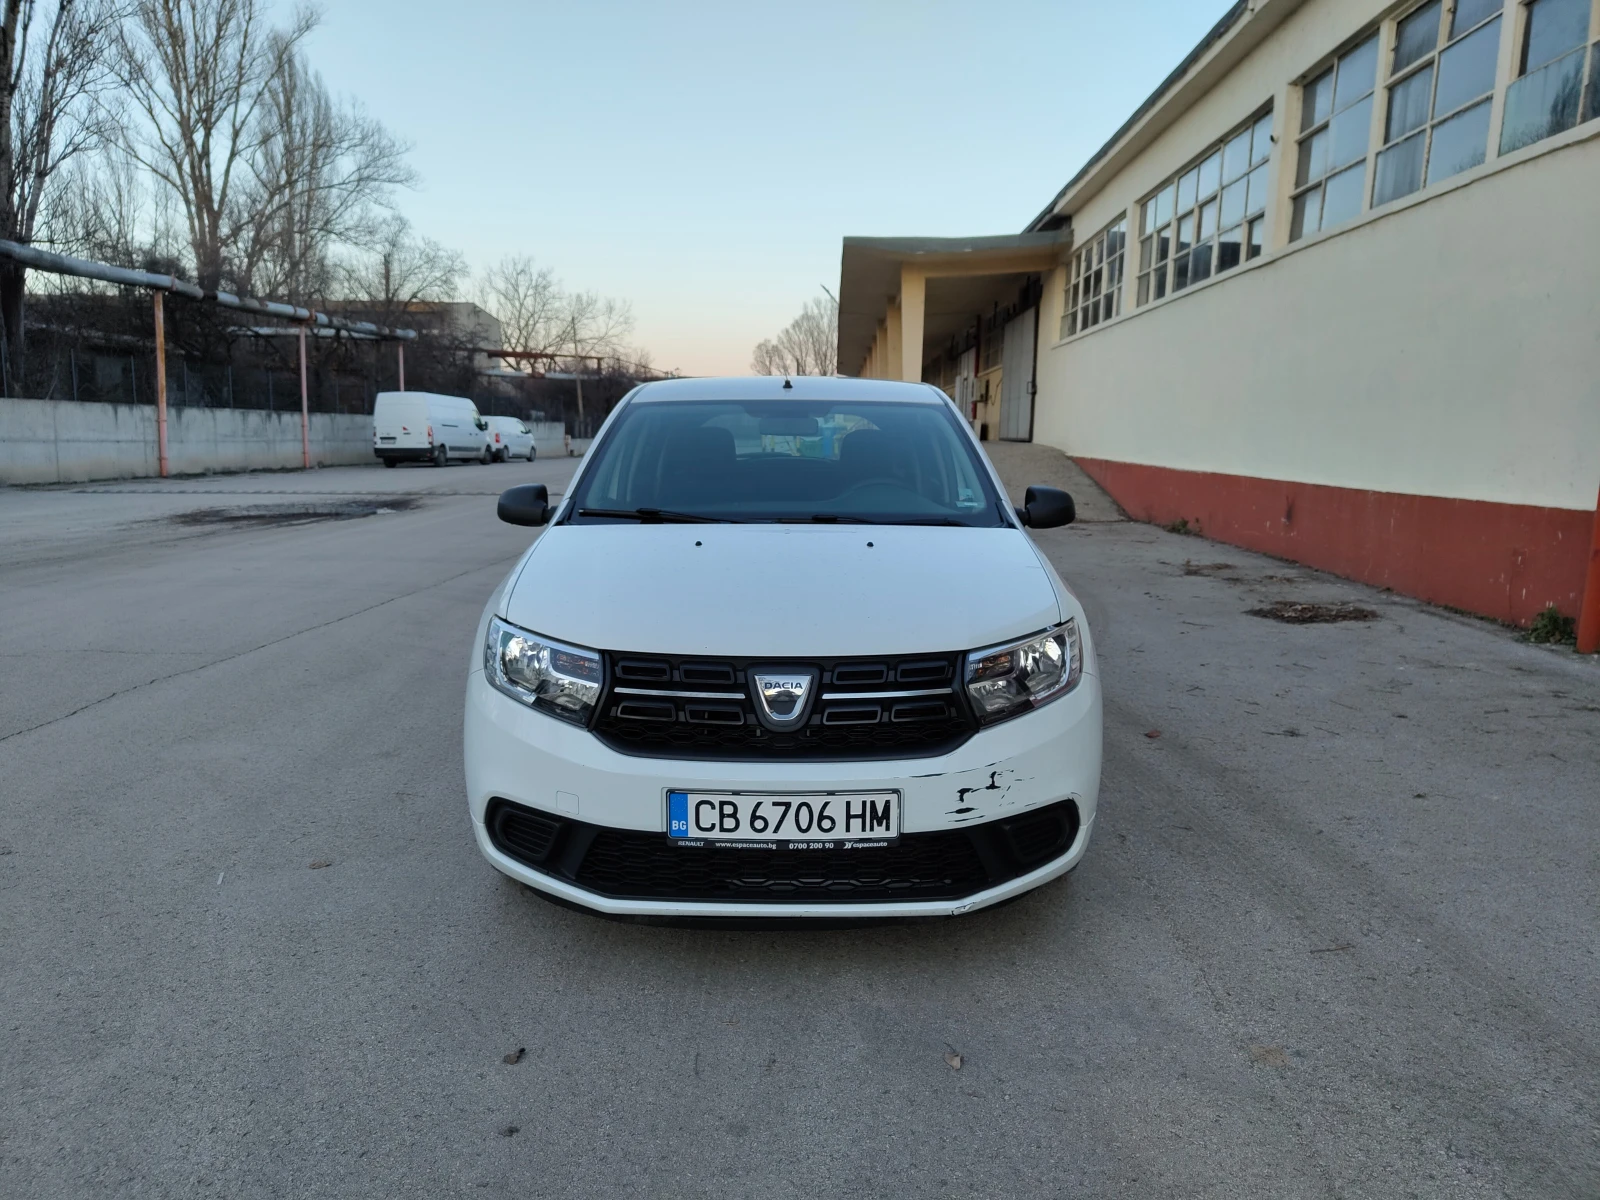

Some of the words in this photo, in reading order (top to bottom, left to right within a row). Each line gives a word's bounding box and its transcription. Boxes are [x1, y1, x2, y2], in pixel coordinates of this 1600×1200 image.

[764, 682, 803, 690] DACIA
[694, 800, 741, 833] CB
[749, 801, 837, 834] 6706
[845, 800, 891, 833] HM
[672, 820, 687, 831] BG
[715, 842, 777, 850] www.espaceauto.bg
[853, 841, 888, 849] espaceauto
